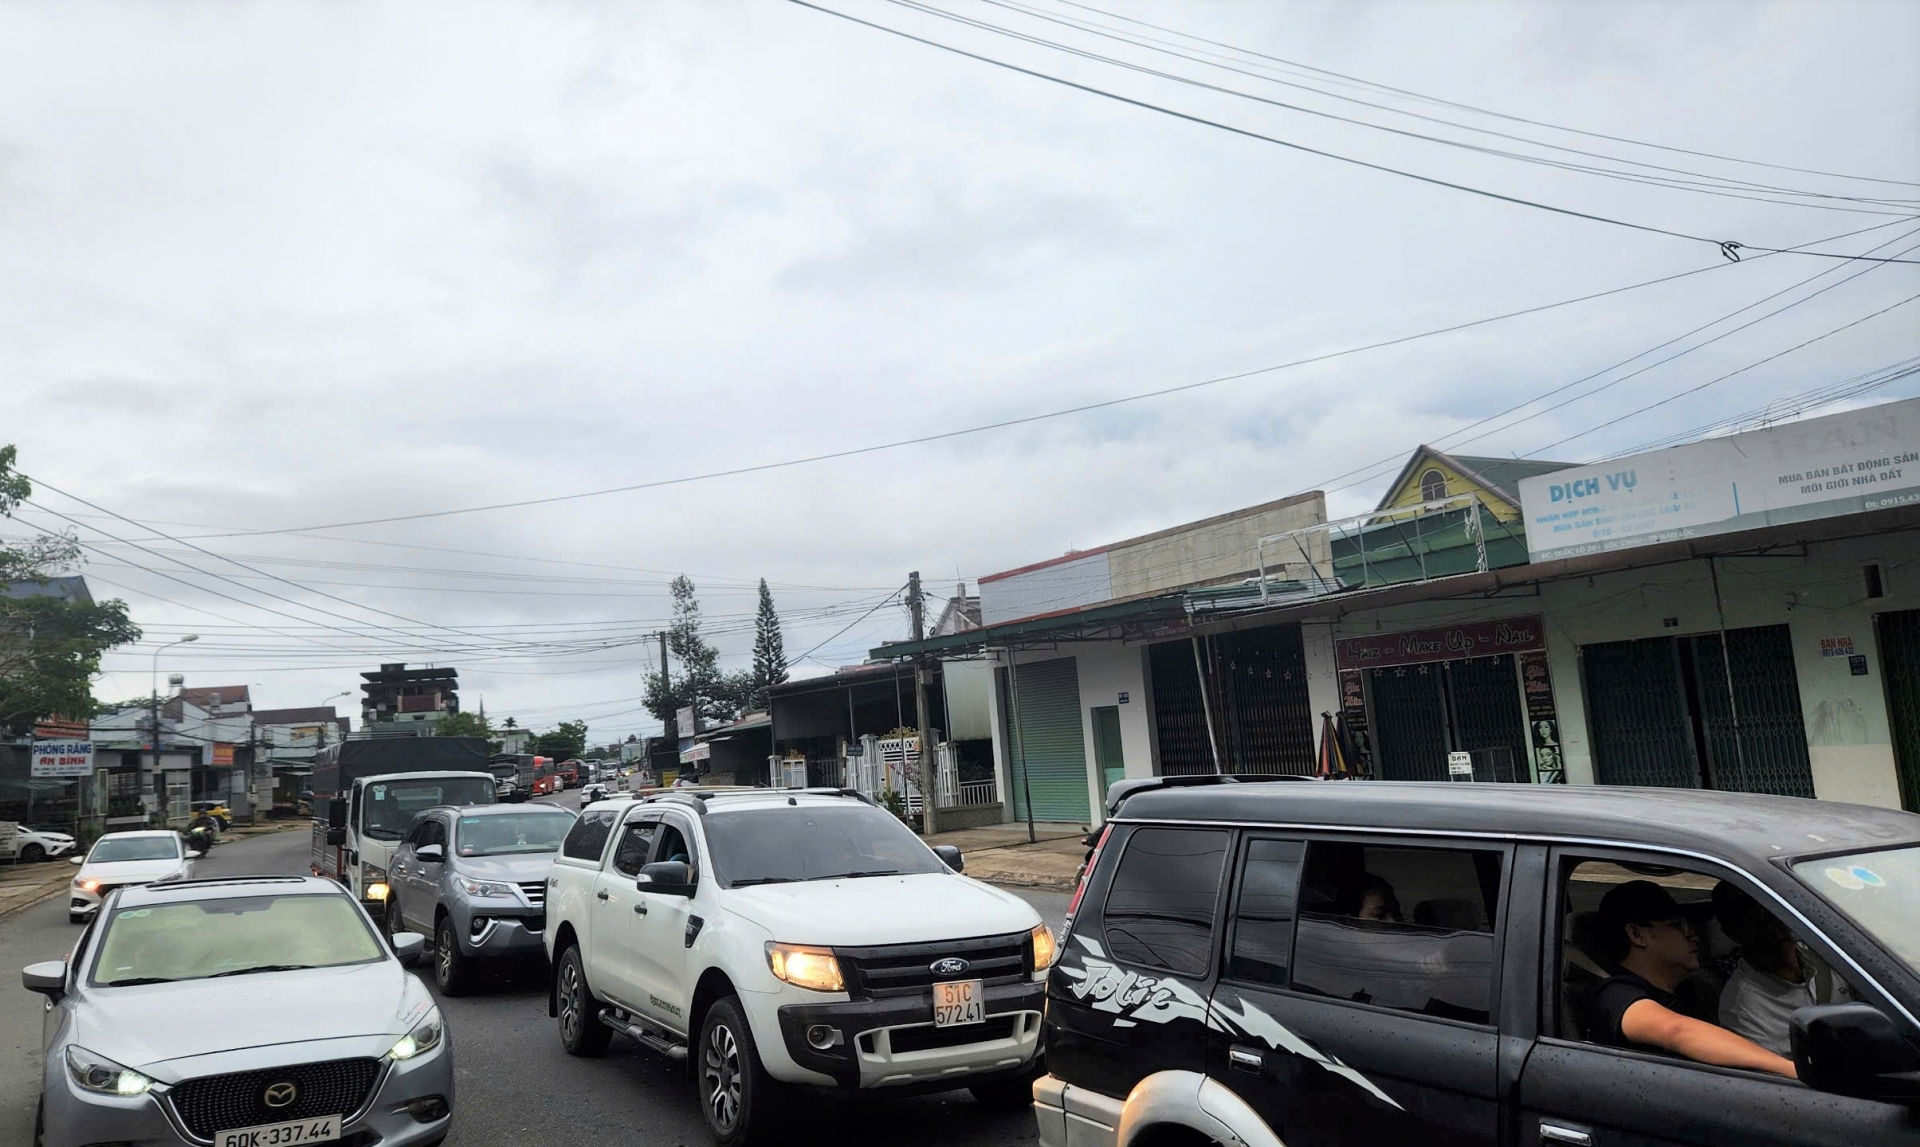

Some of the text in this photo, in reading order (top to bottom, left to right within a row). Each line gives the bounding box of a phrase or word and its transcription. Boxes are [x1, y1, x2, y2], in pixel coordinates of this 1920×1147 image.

[1778, 450, 1919, 485] MUA BÁN BẤT ĐỘNG SẢN
[1826, 478, 1849, 491] GIỚI
[1852, 472, 1877, 486] NHÀ
[1880, 466, 1903, 481] ĐẤT
[1549, 470, 1638, 503] DỊCH VỤ
[941, 960, 962, 972] Ford
[945, 984, 972, 1003] 51C
[1072, 966, 1173, 1009] Jolie
[936, 1002, 981, 1024] 572.41
[226, 1121, 331, 1147] 60K-337.44
